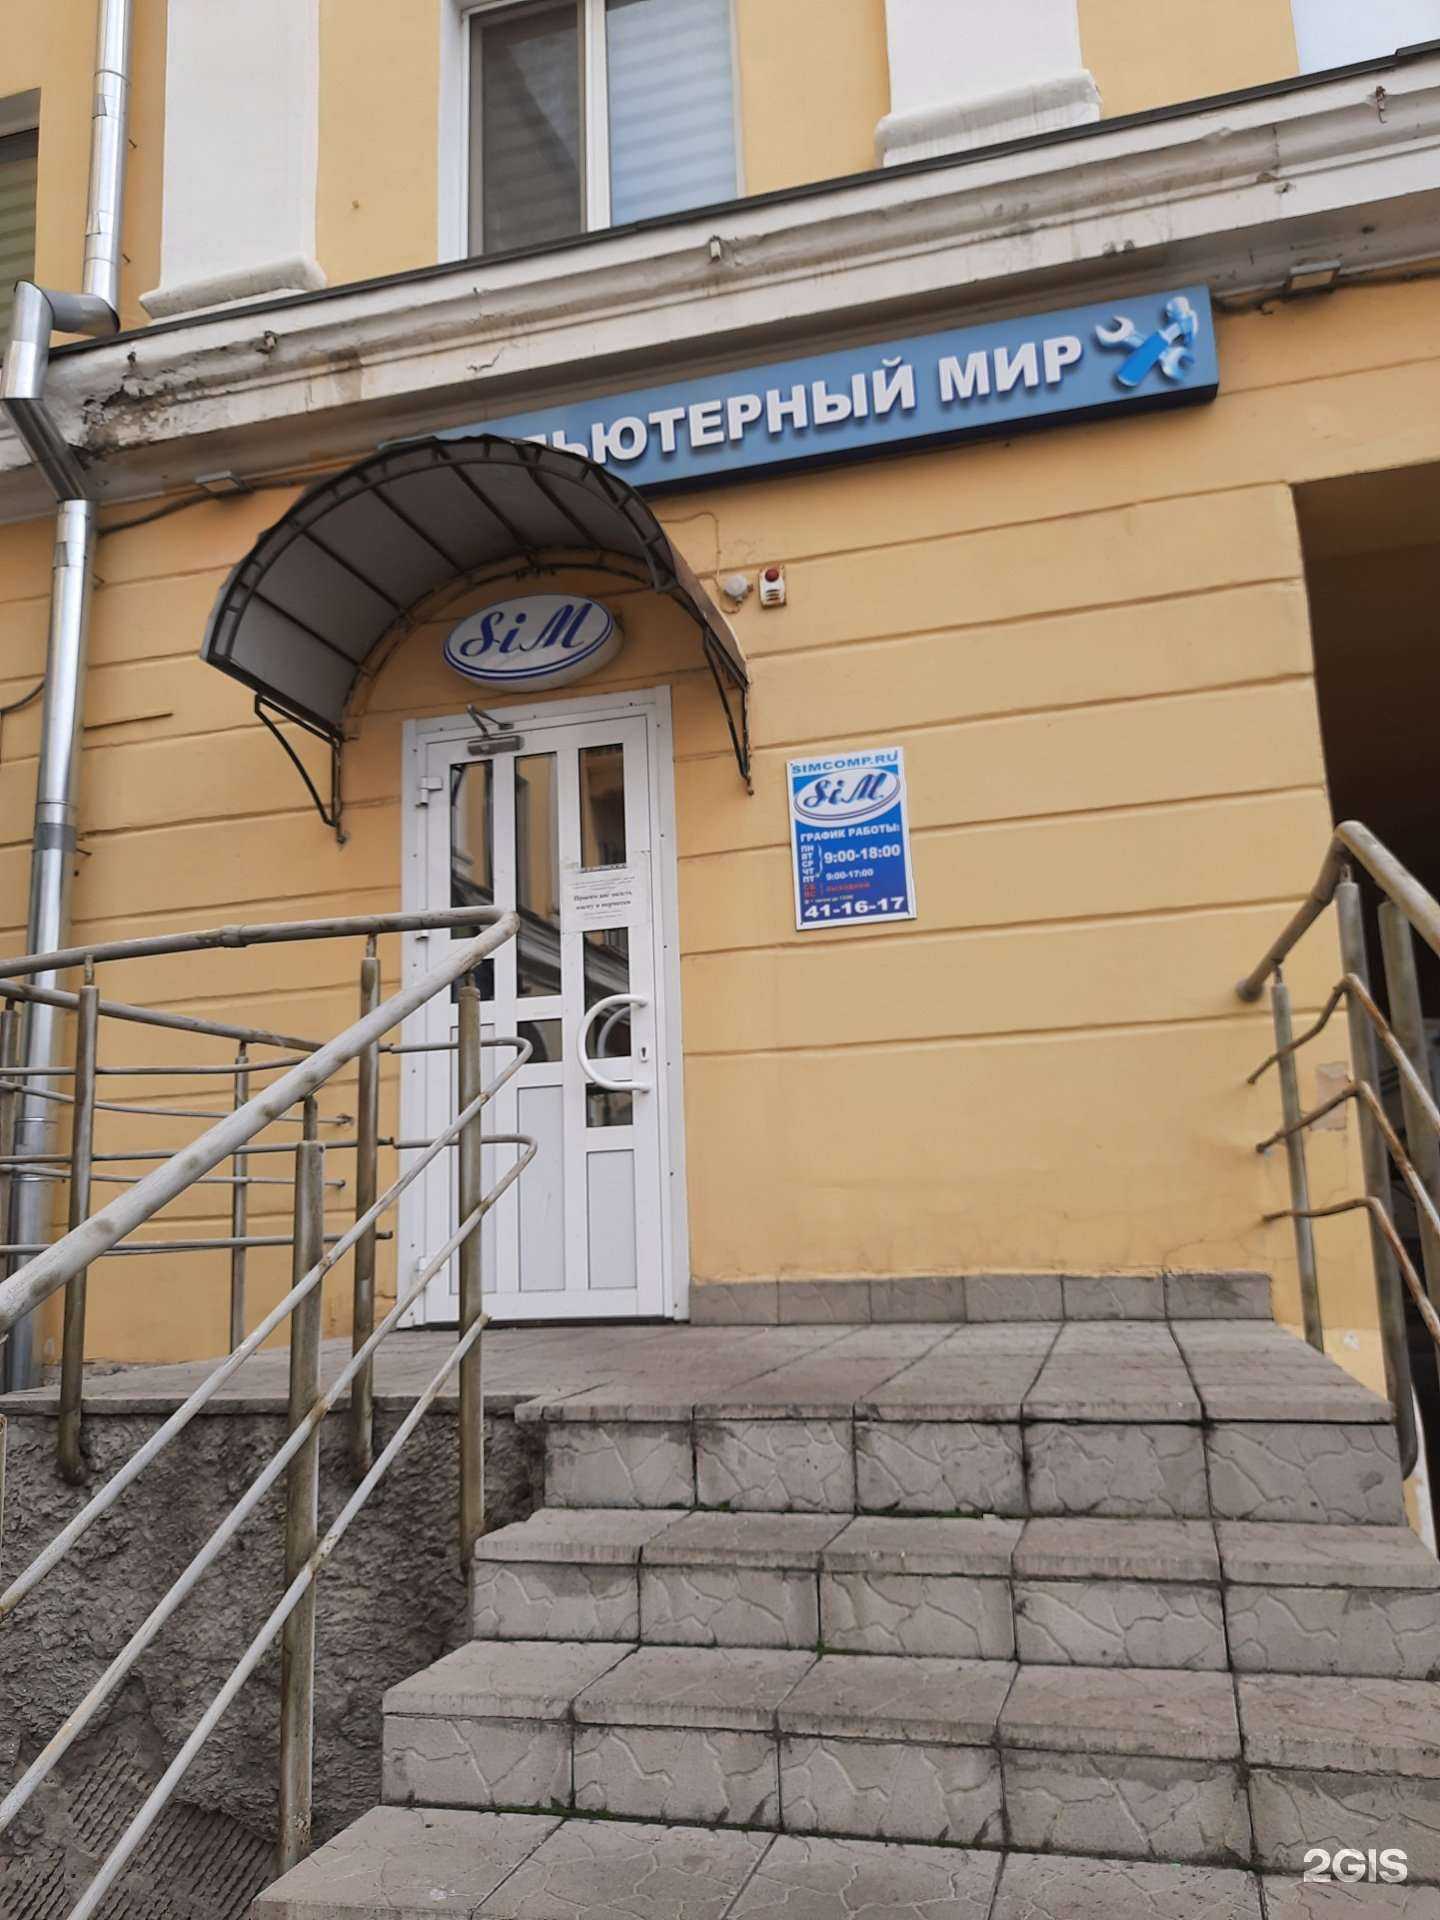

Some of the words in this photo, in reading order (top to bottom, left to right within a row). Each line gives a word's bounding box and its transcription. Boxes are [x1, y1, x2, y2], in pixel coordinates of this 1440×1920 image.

[523, 359, 917, 464] ЬЮТЕРНЫЙ
[937, 334, 1084, 403] МИР
[791, 750, 899, 775] SIMCOMP.RU
[800, 828, 846, 843] ГРАФИК
[847, 823, 900, 838] РАБОТЫ:
[800, 844, 815, 853] ПН
[823, 843, 901, 864] 9:00-18:00
[801, 860, 814, 868] СР
[825, 867, 875, 881] 9:00-17:00
[804, 896, 905, 918] 41-16-17
